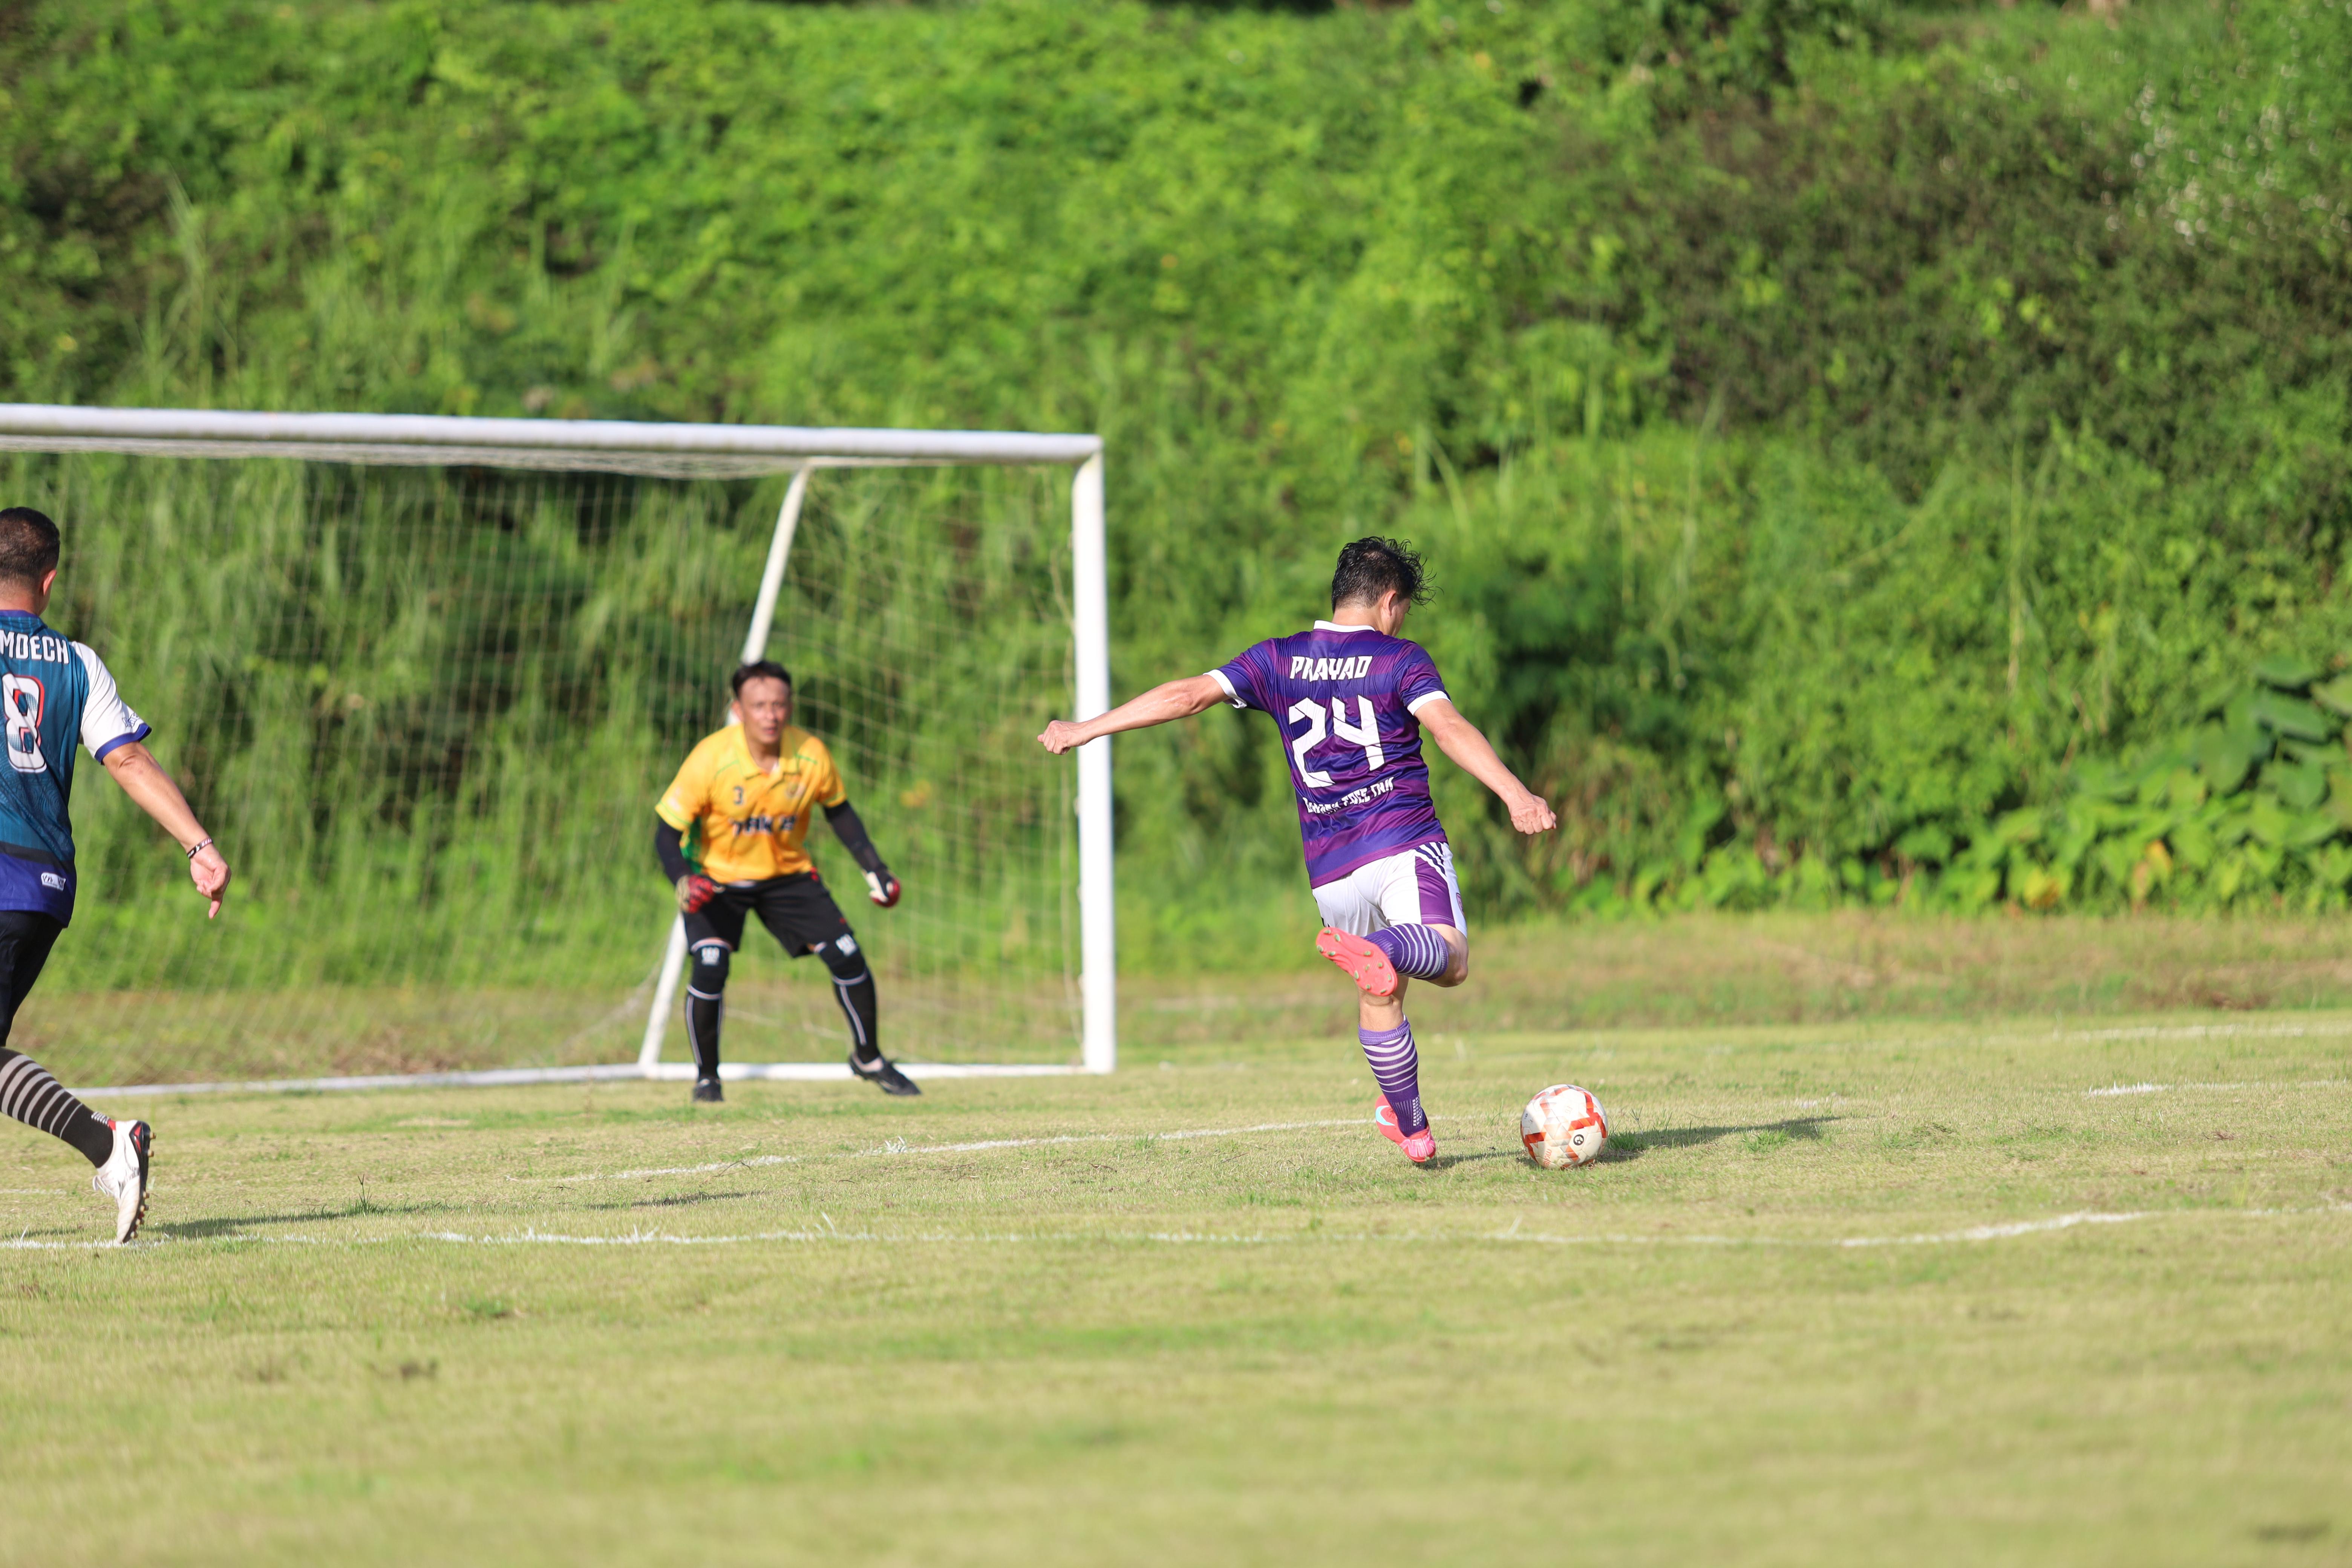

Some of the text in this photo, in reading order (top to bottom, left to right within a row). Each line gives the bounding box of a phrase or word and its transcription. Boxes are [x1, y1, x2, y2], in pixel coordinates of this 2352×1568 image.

[1289, 655, 1372, 682] PRAYAD
[2, 672, 47, 773] 8
[1288, 694, 1385, 788] 24
